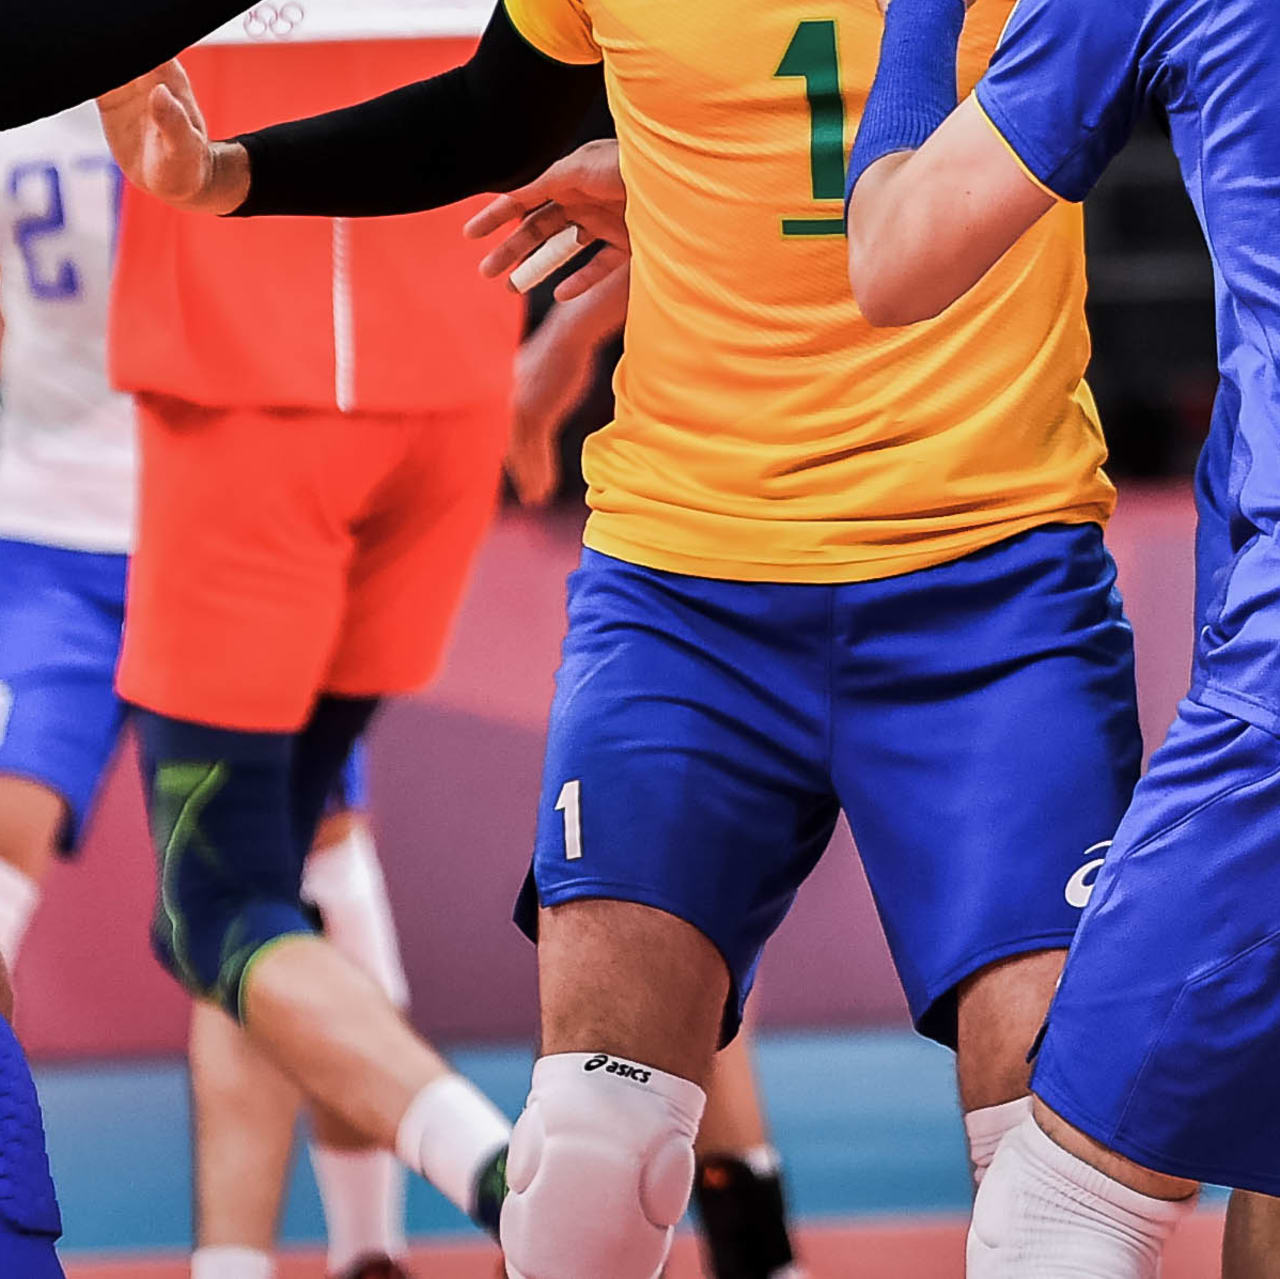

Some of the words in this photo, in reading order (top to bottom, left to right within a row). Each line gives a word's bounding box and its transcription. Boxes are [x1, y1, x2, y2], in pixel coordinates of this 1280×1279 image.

[773, 19, 846, 201] 1
[553, 778, 584, 861] 1
[605, 1061, 652, 1084] asics
